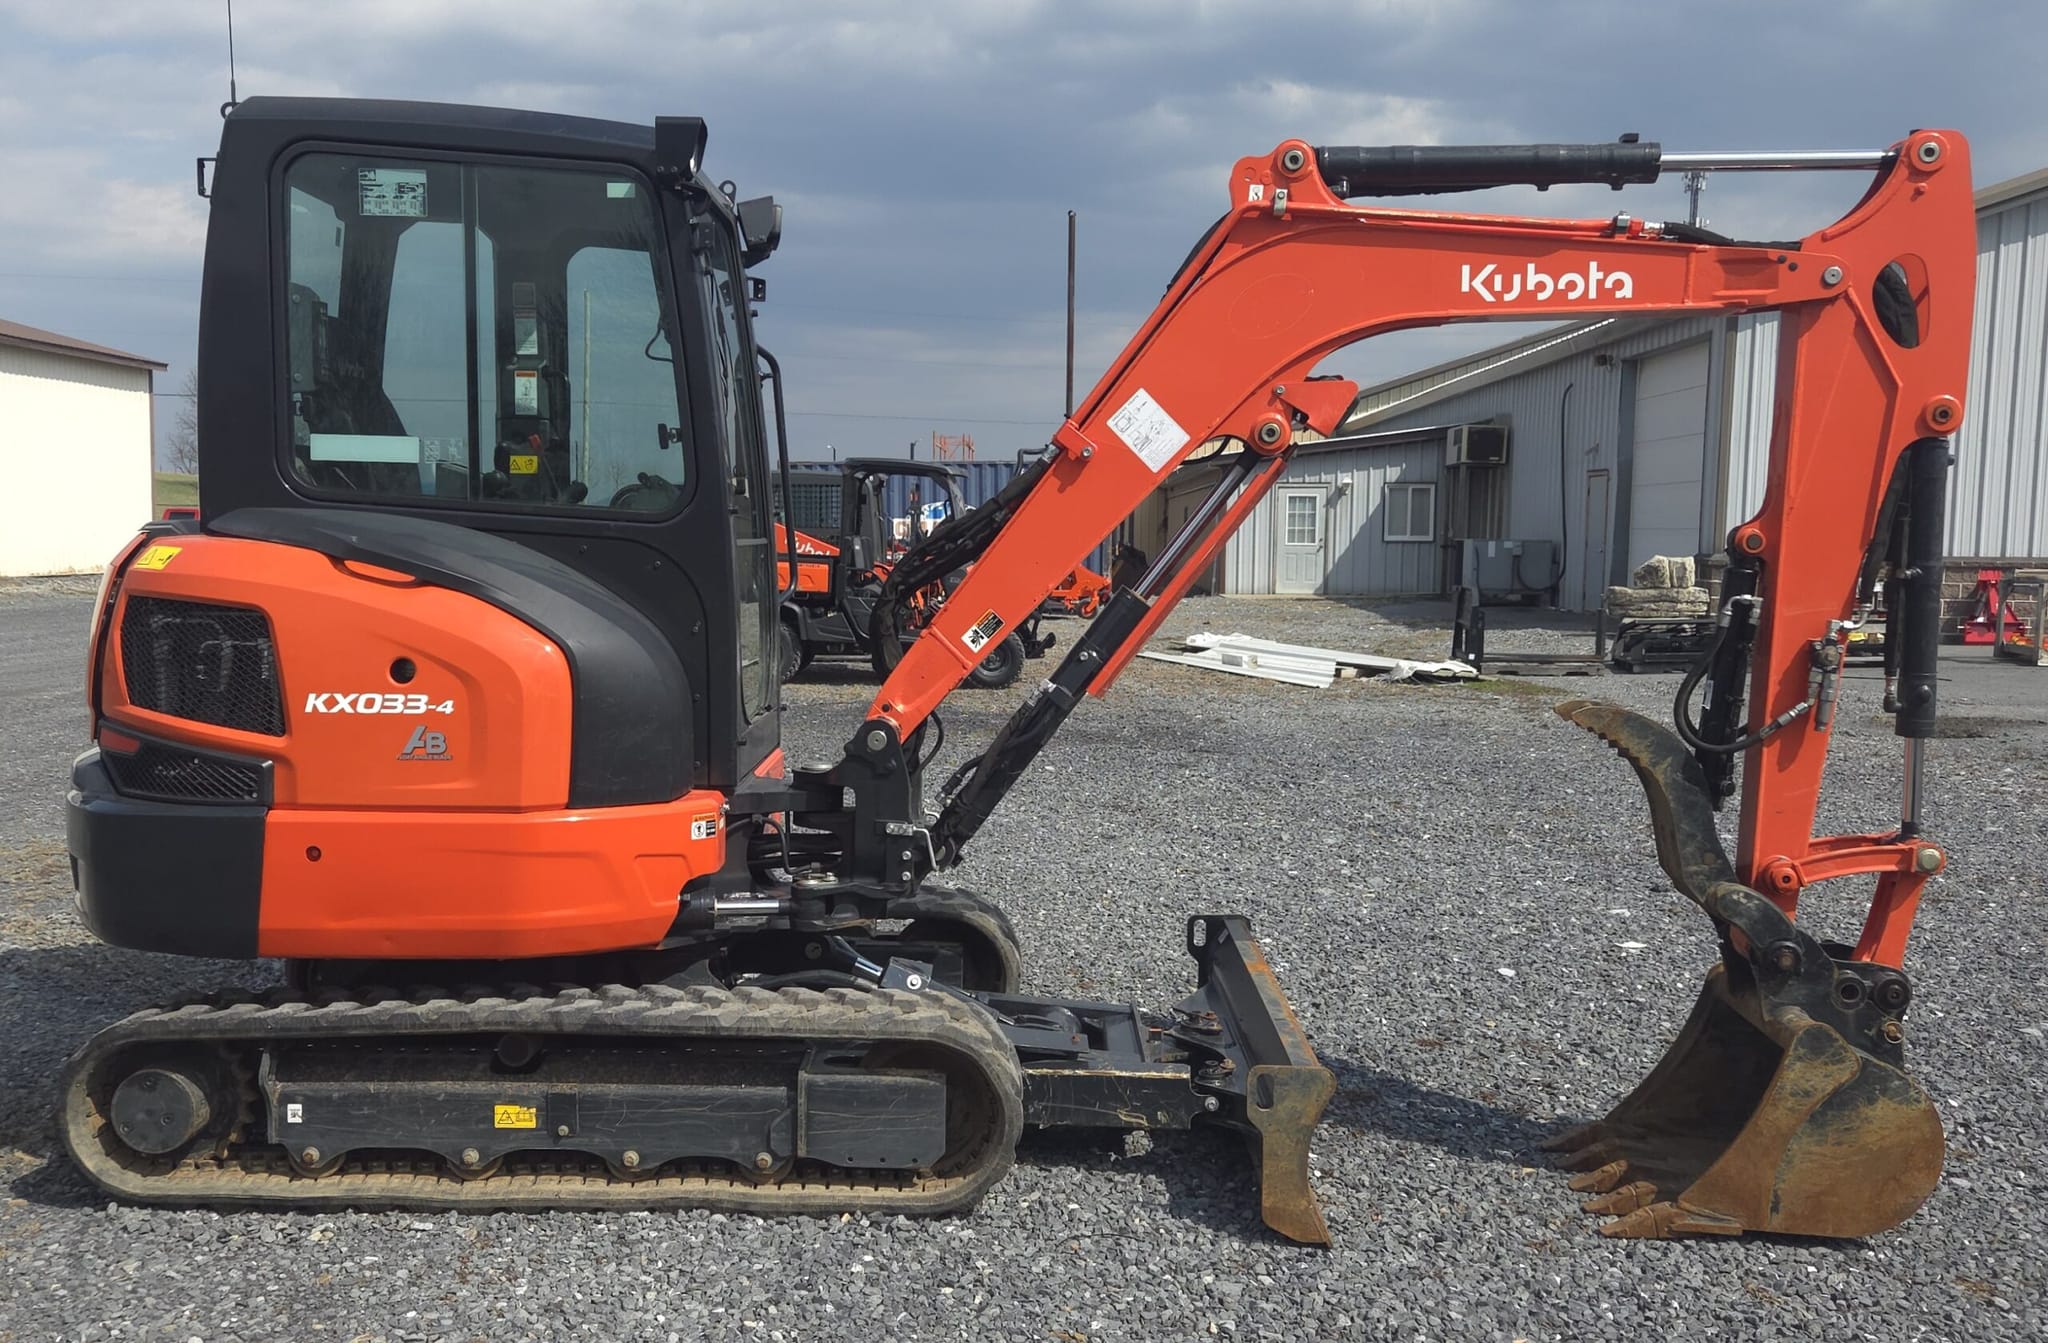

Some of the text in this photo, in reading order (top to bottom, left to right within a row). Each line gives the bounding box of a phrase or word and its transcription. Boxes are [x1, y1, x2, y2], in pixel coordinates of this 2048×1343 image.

[1461, 260, 1633, 302] Kubota
[304, 693, 455, 714] KX033-4
[402, 725, 448, 754] AB
